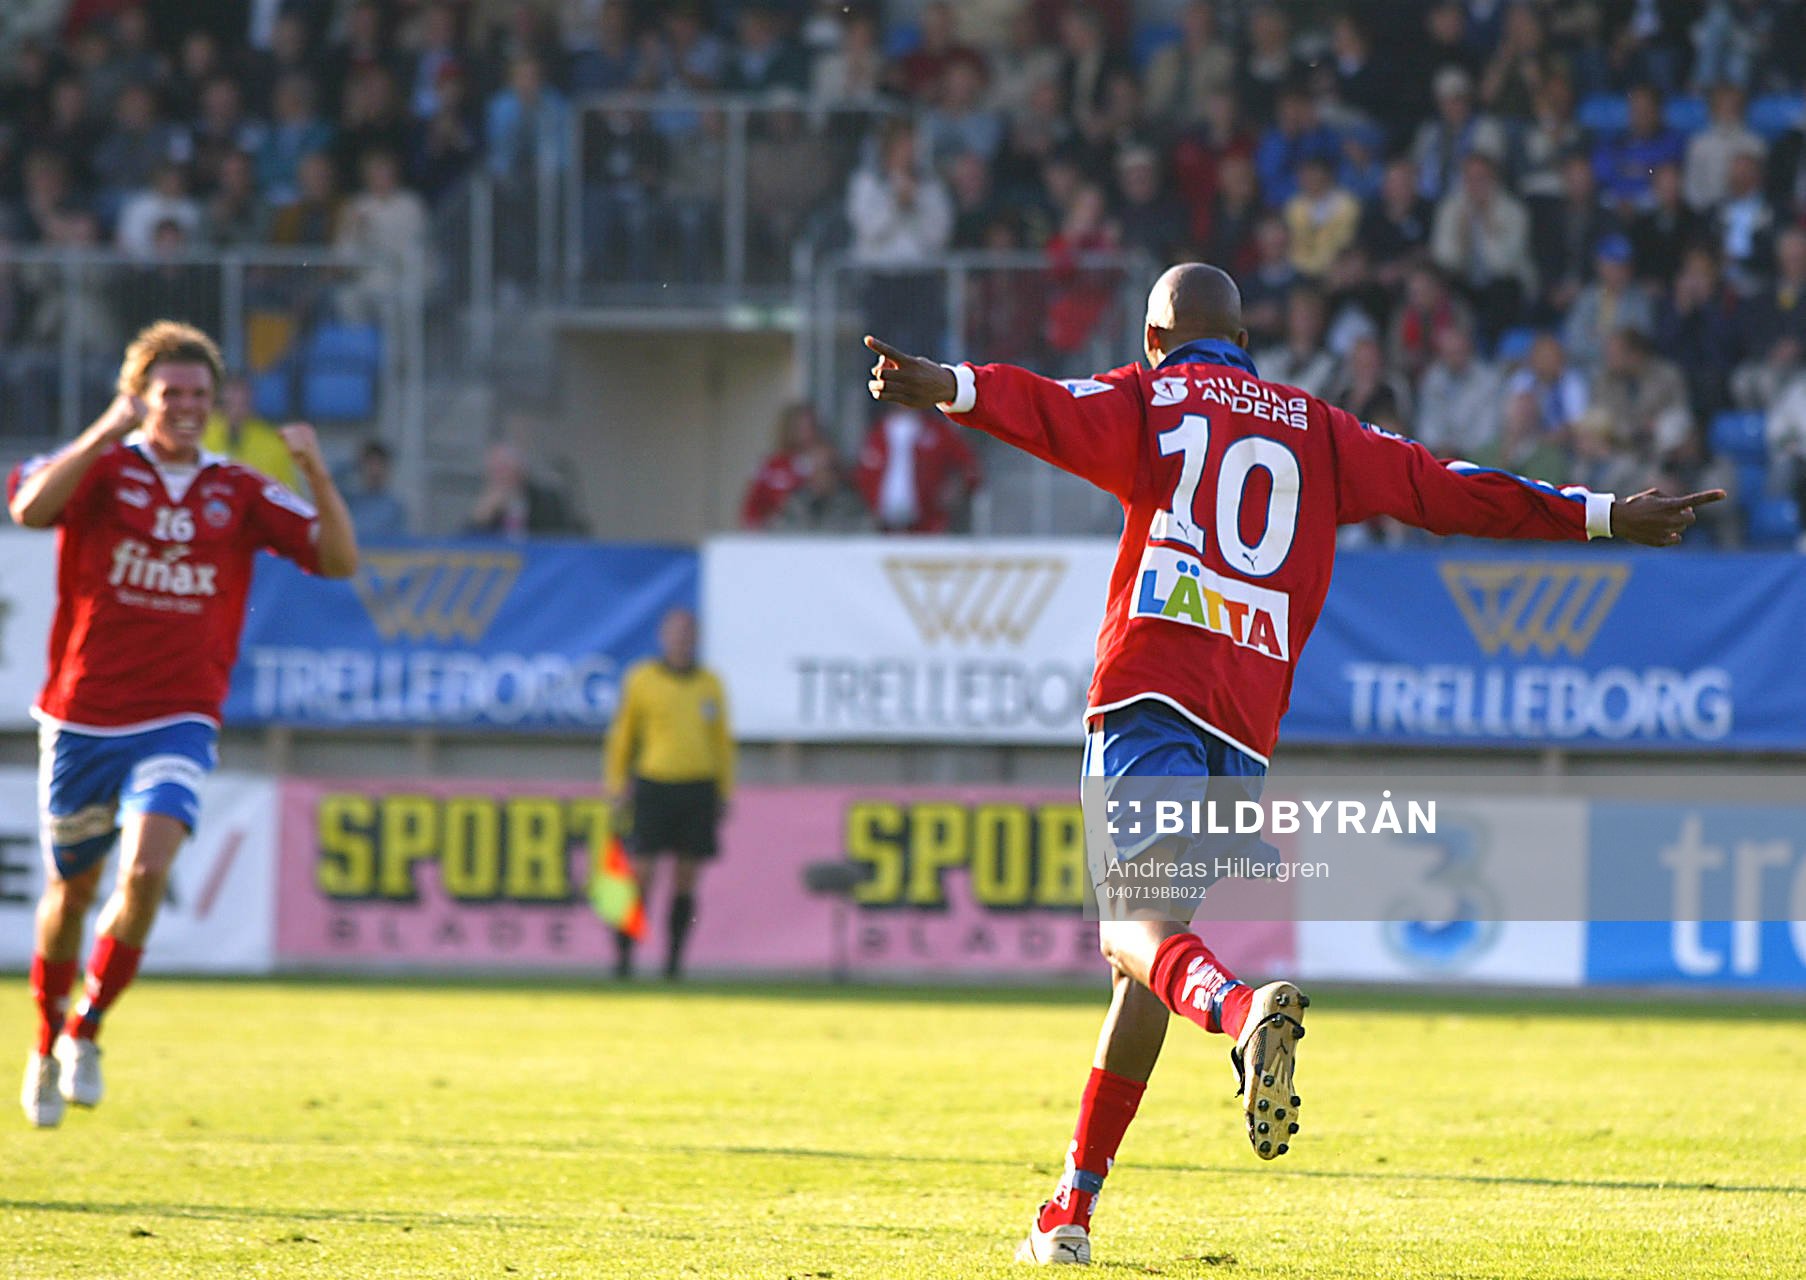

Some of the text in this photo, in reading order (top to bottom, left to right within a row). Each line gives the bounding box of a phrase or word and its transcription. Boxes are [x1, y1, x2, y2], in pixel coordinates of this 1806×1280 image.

[1194, 376, 1308, 413] HILDING
[1202, 388, 1308, 431] ANDERS
[153, 507, 195, 543] 16
[1150, 413, 1301, 578] 10
[109, 540, 217, 596] finax
[1137, 560, 1283, 657] LÄTTA
[253, 648, 613, 722] TRELLEBORG
[1350, 664, 1731, 738] TRELLEBORG
[316, 793, 610, 902] SPORT
[331, 920, 570, 949] BLADE
